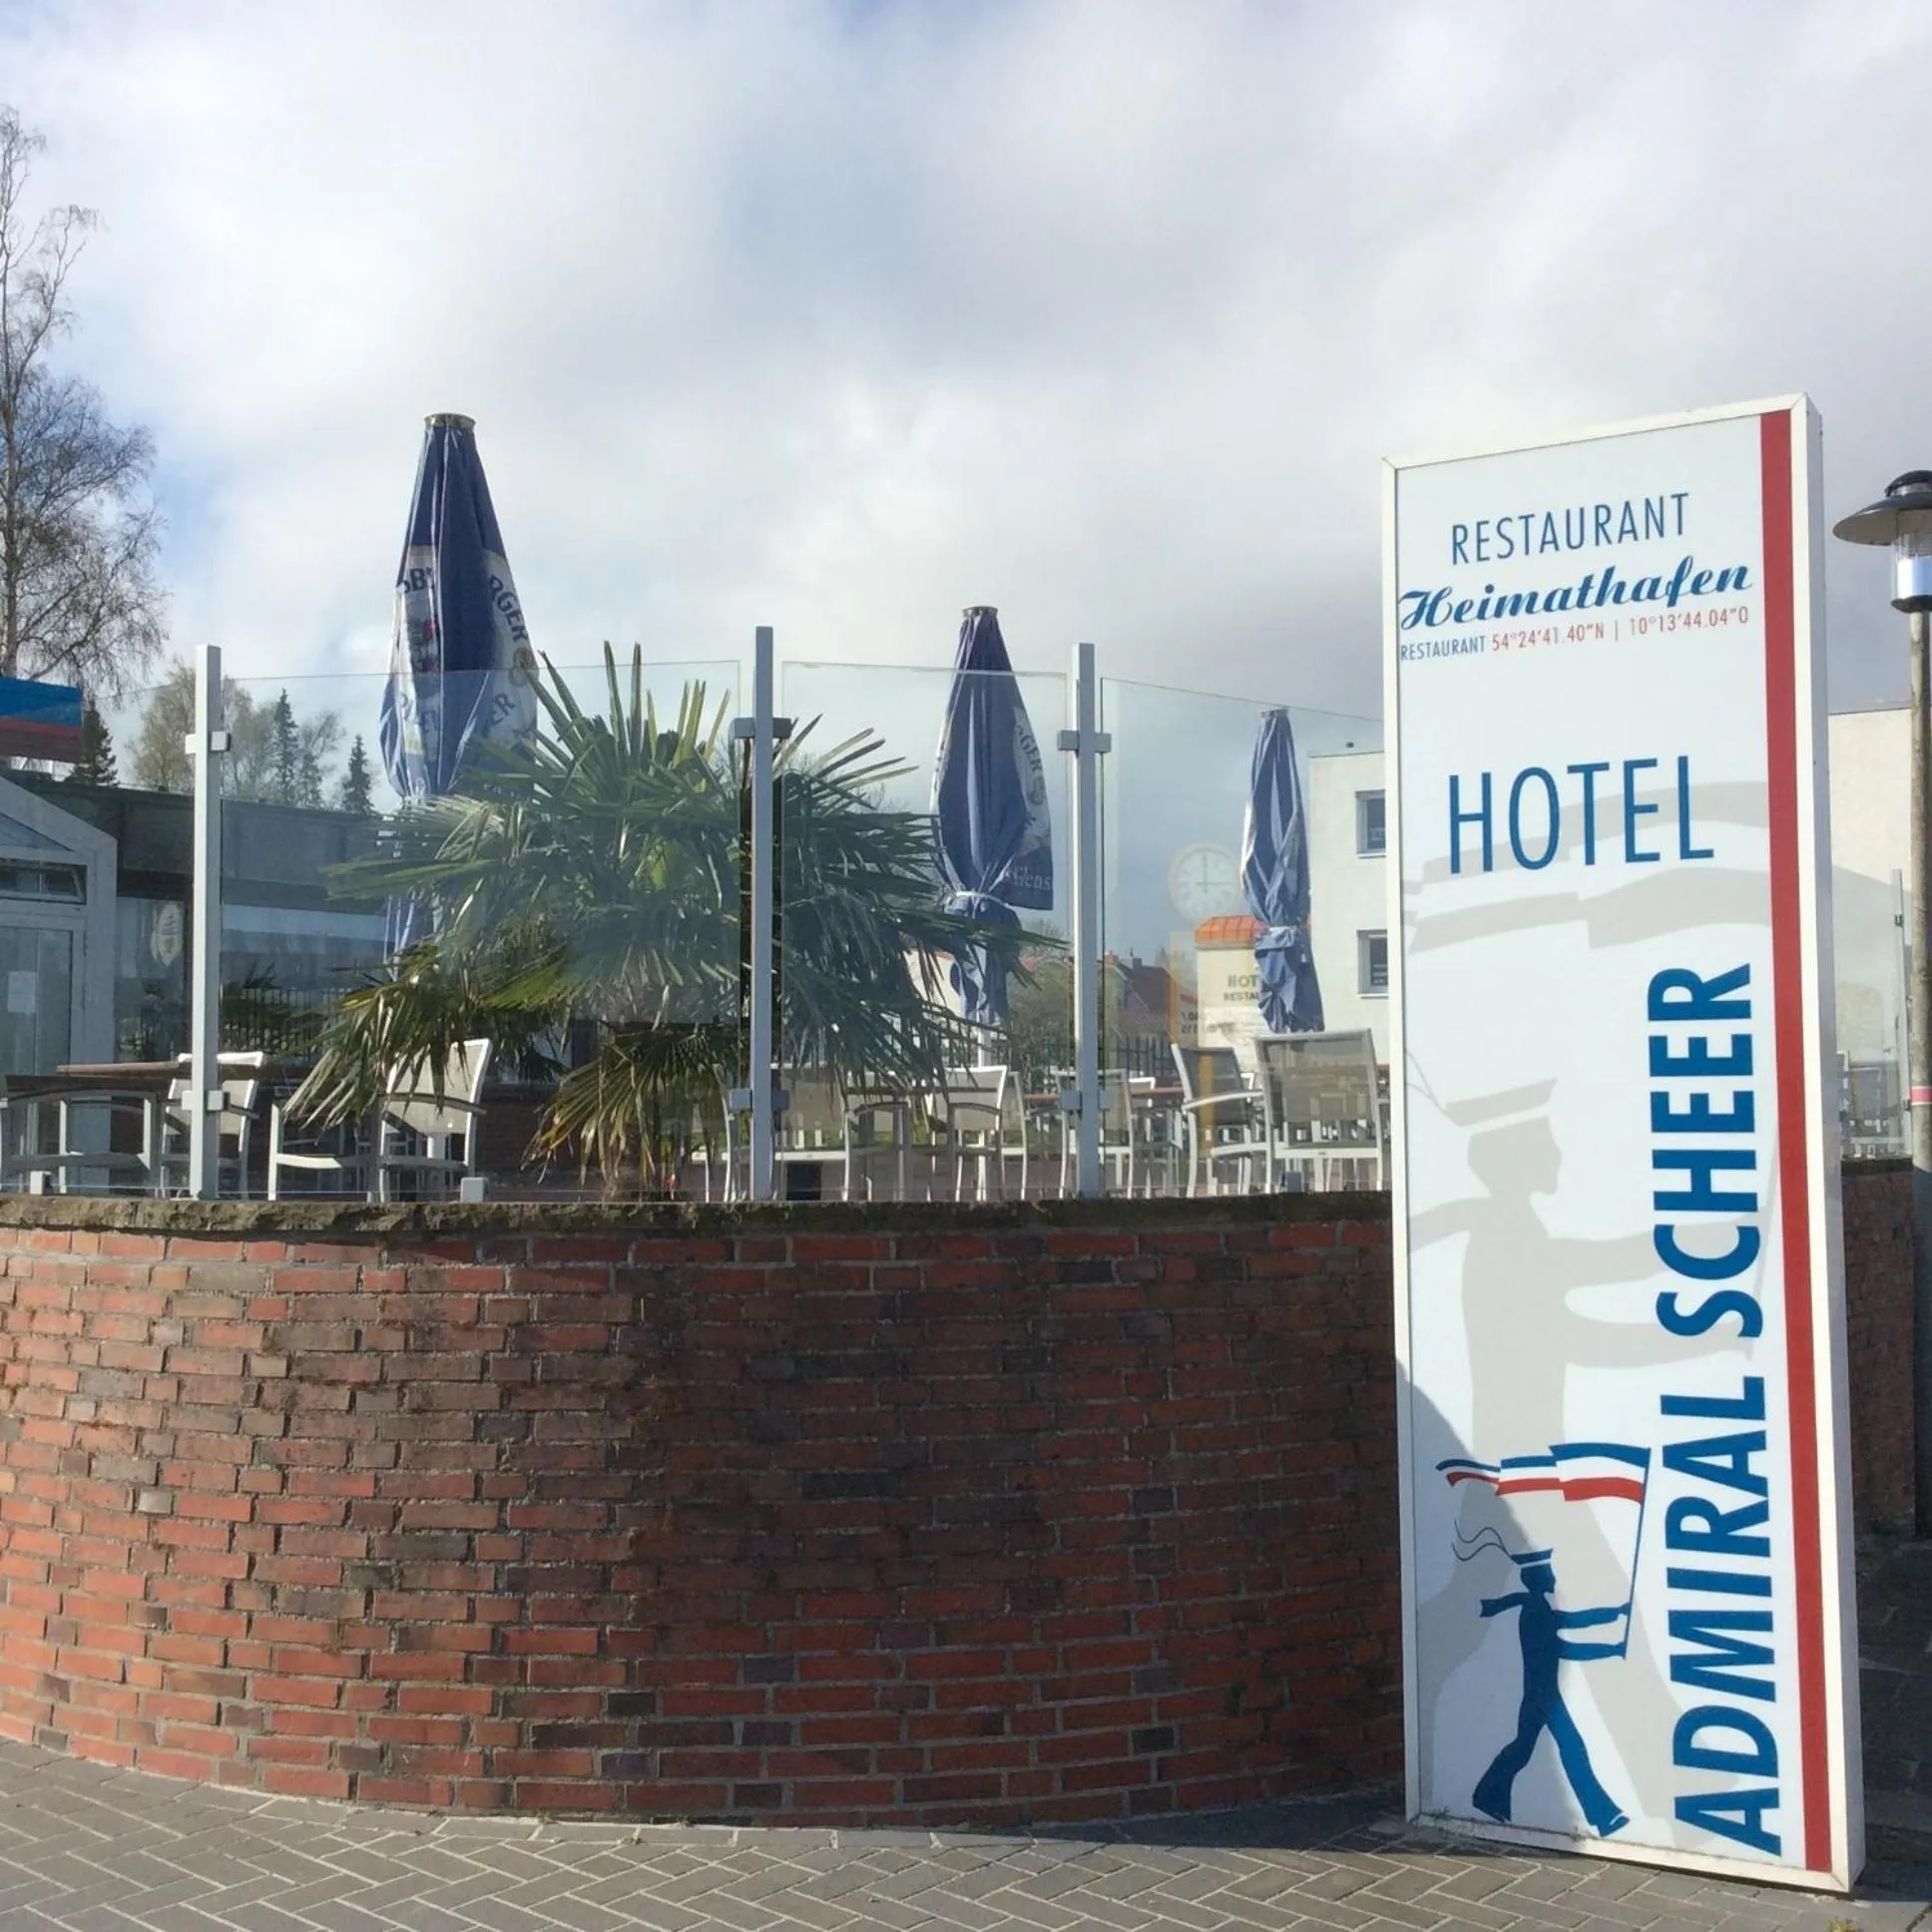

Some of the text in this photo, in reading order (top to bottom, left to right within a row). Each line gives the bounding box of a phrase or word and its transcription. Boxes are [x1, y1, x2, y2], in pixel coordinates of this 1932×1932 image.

[1451, 492, 1690, 566] RESTAURANT
[1397, 555, 1754, 631] Heimathafen
[1400, 635, 1486, 661] RESTAURANT
[1448, 755, 1715, 875] HOTEL
[1647, 962, 1782, 1857] ADMIRAL SCHEER
